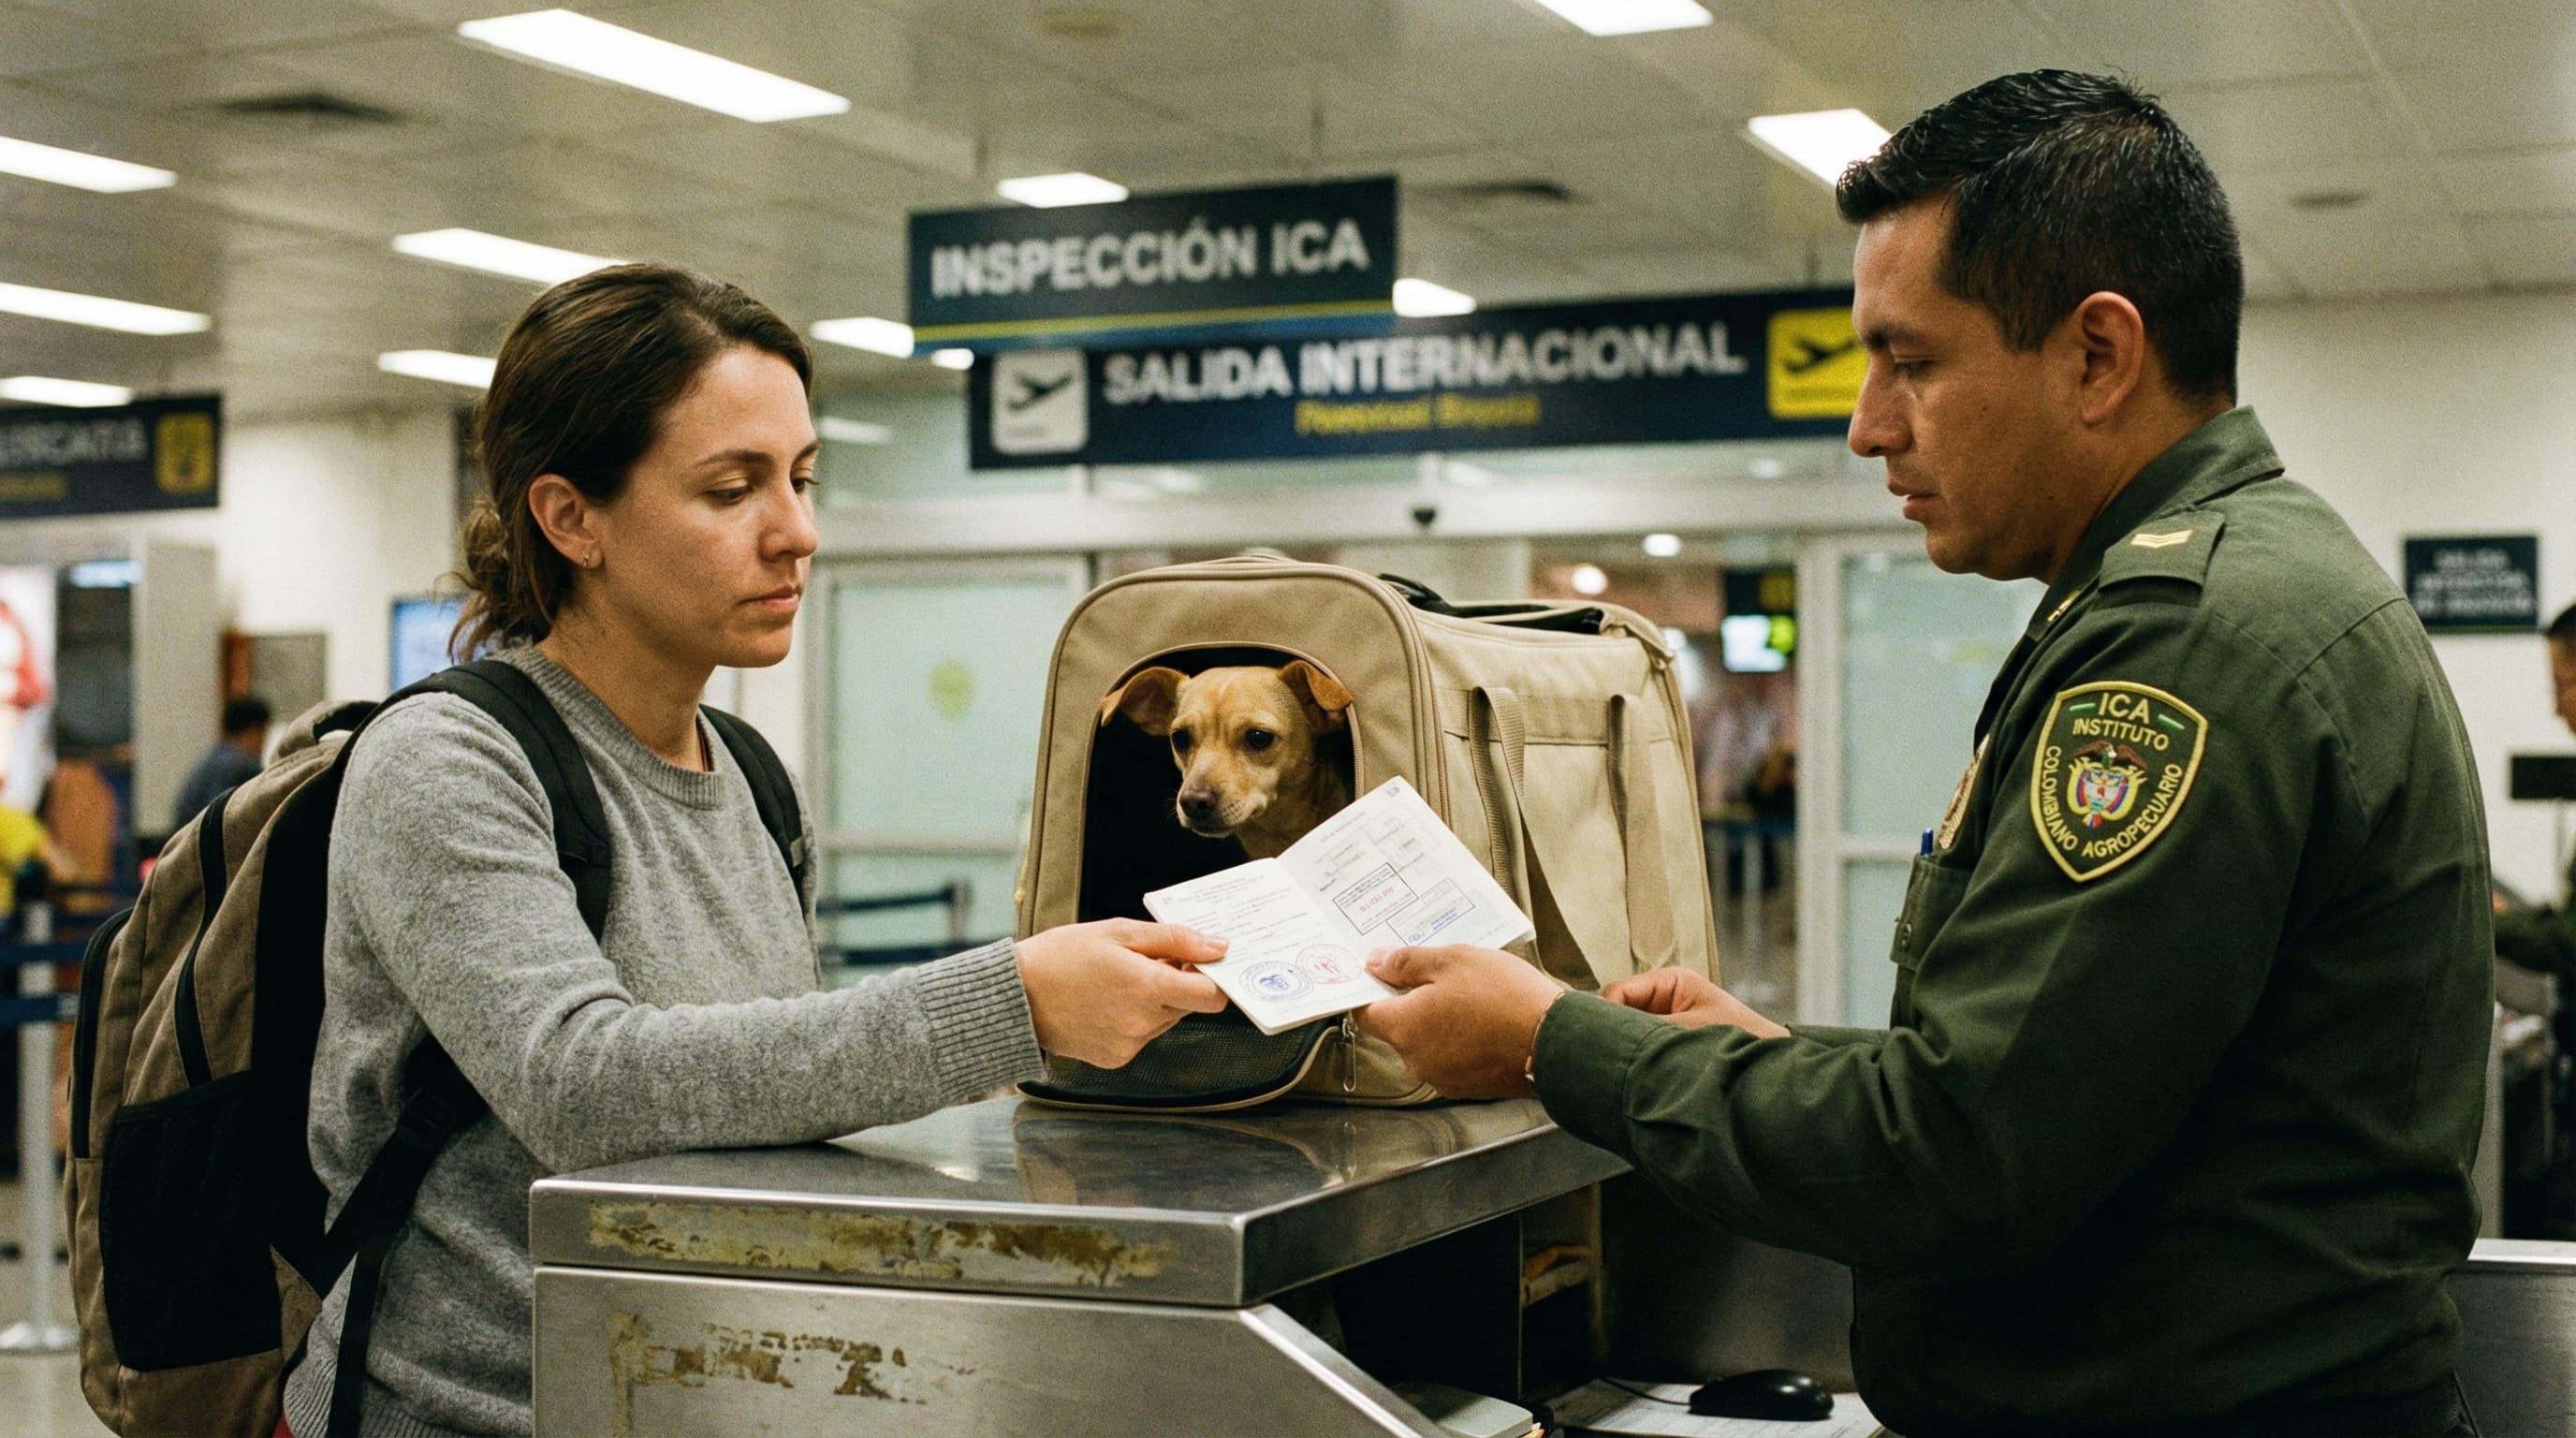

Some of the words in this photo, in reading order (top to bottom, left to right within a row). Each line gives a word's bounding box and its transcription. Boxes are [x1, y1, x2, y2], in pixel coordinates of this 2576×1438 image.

[931, 218, 1257, 299] INSPECCIÓN
[1270, 218, 1368, 276] ICA
[1104, 347, 1291, 404] SALIDA
[1299, 322, 1746, 394] INTERNACIONAL
[2072, 718, 2169, 751] INSTITUTO
[2099, 693, 2150, 724] ICA
[2042, 745, 2078, 851] COLOMBIANO
[2082, 763, 2183, 858] AGROPECUARIO
